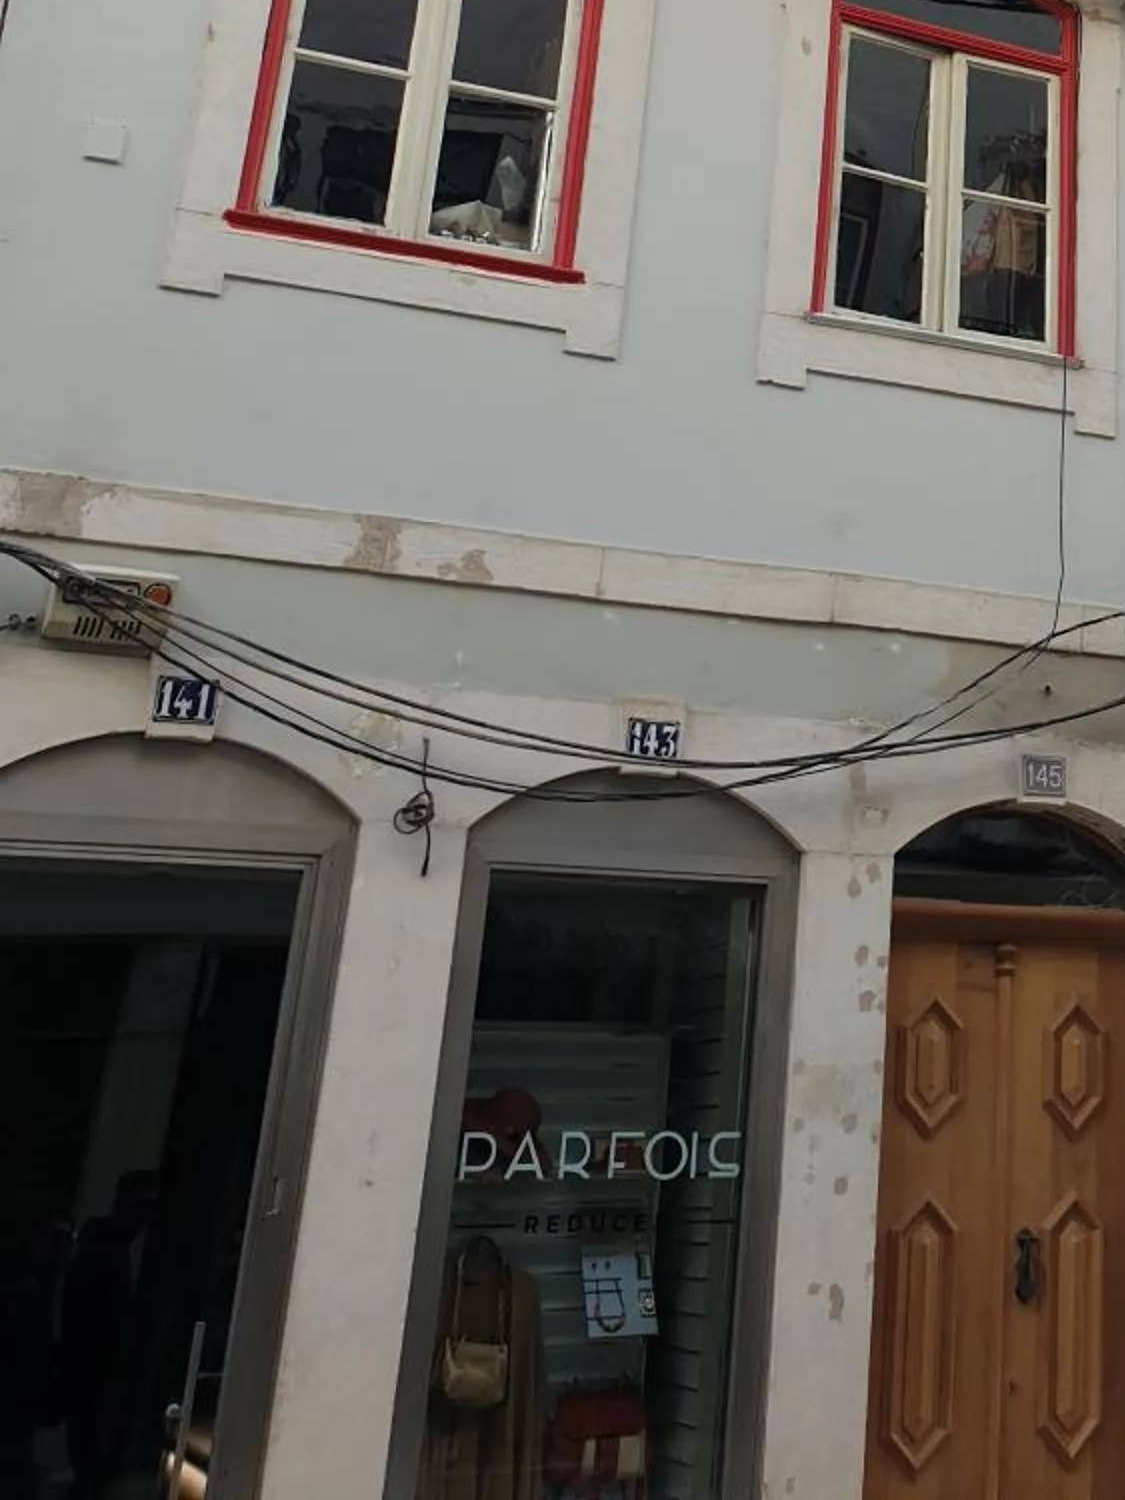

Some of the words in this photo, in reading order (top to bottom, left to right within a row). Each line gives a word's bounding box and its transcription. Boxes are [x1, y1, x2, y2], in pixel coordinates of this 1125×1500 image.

[157, 680, 211, 720] 141
[631, 721, 678, 758] 143
[1028, 763, 1063, 789] 145
[458, 1130, 742, 1181] PARFOIS
